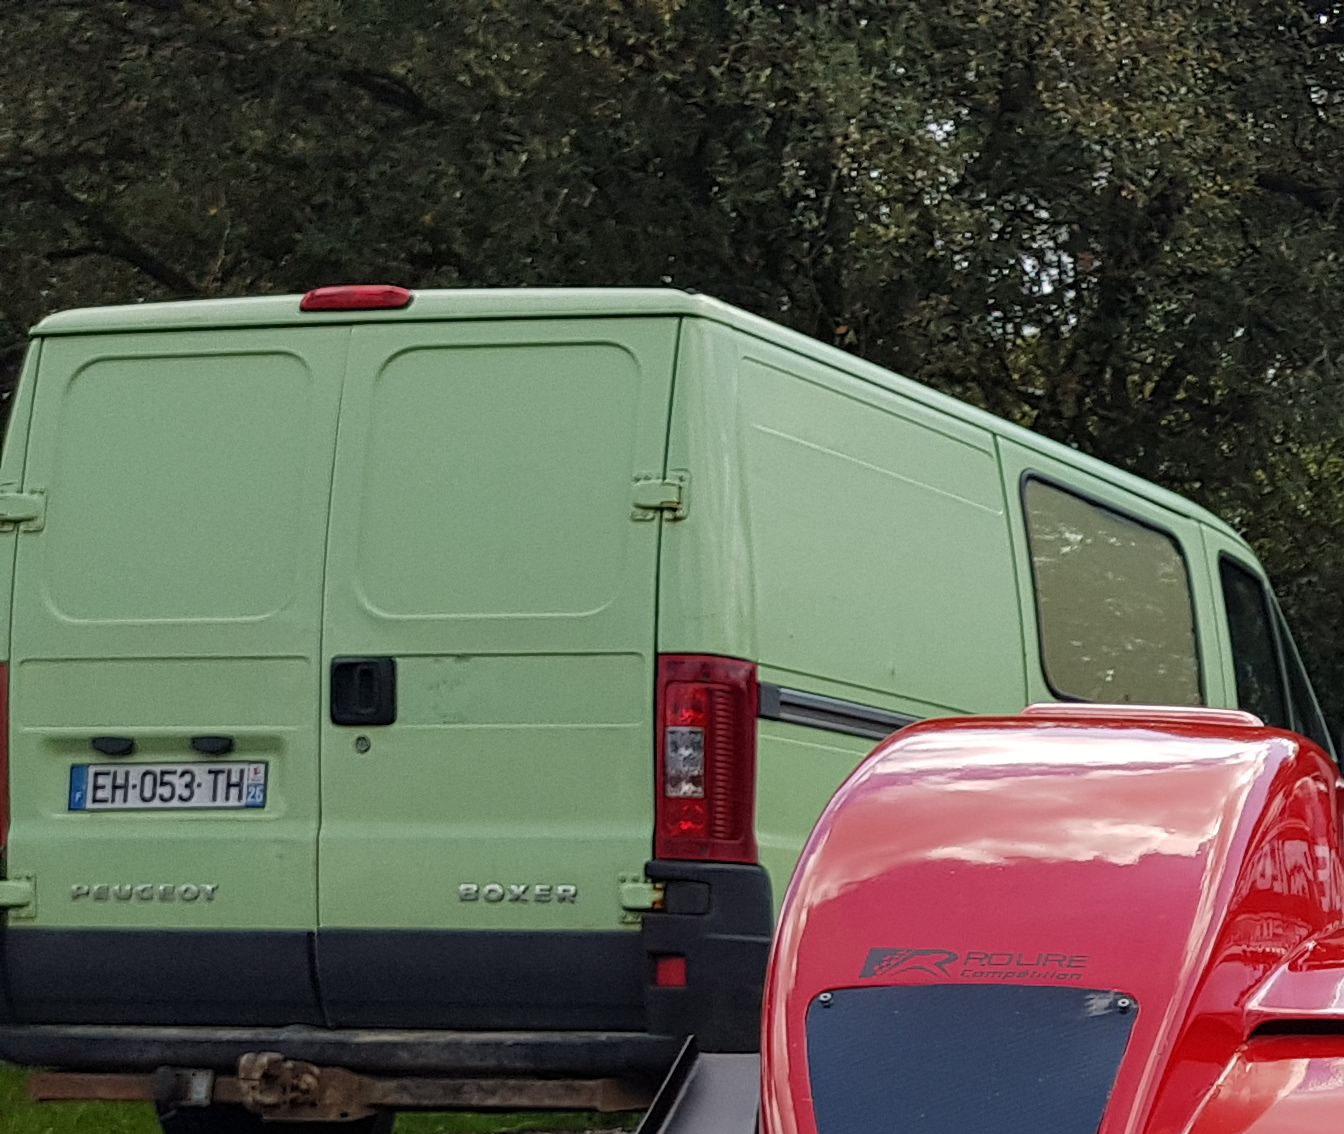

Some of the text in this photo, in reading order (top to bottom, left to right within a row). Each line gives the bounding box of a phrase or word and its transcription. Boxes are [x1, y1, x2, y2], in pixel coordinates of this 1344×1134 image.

[248, 785, 264, 802] 26
[71, 884, 219, 902] PEUGEOT
[459, 883, 578, 904] BOXER
[964, 951, 1091, 969] ROURE
